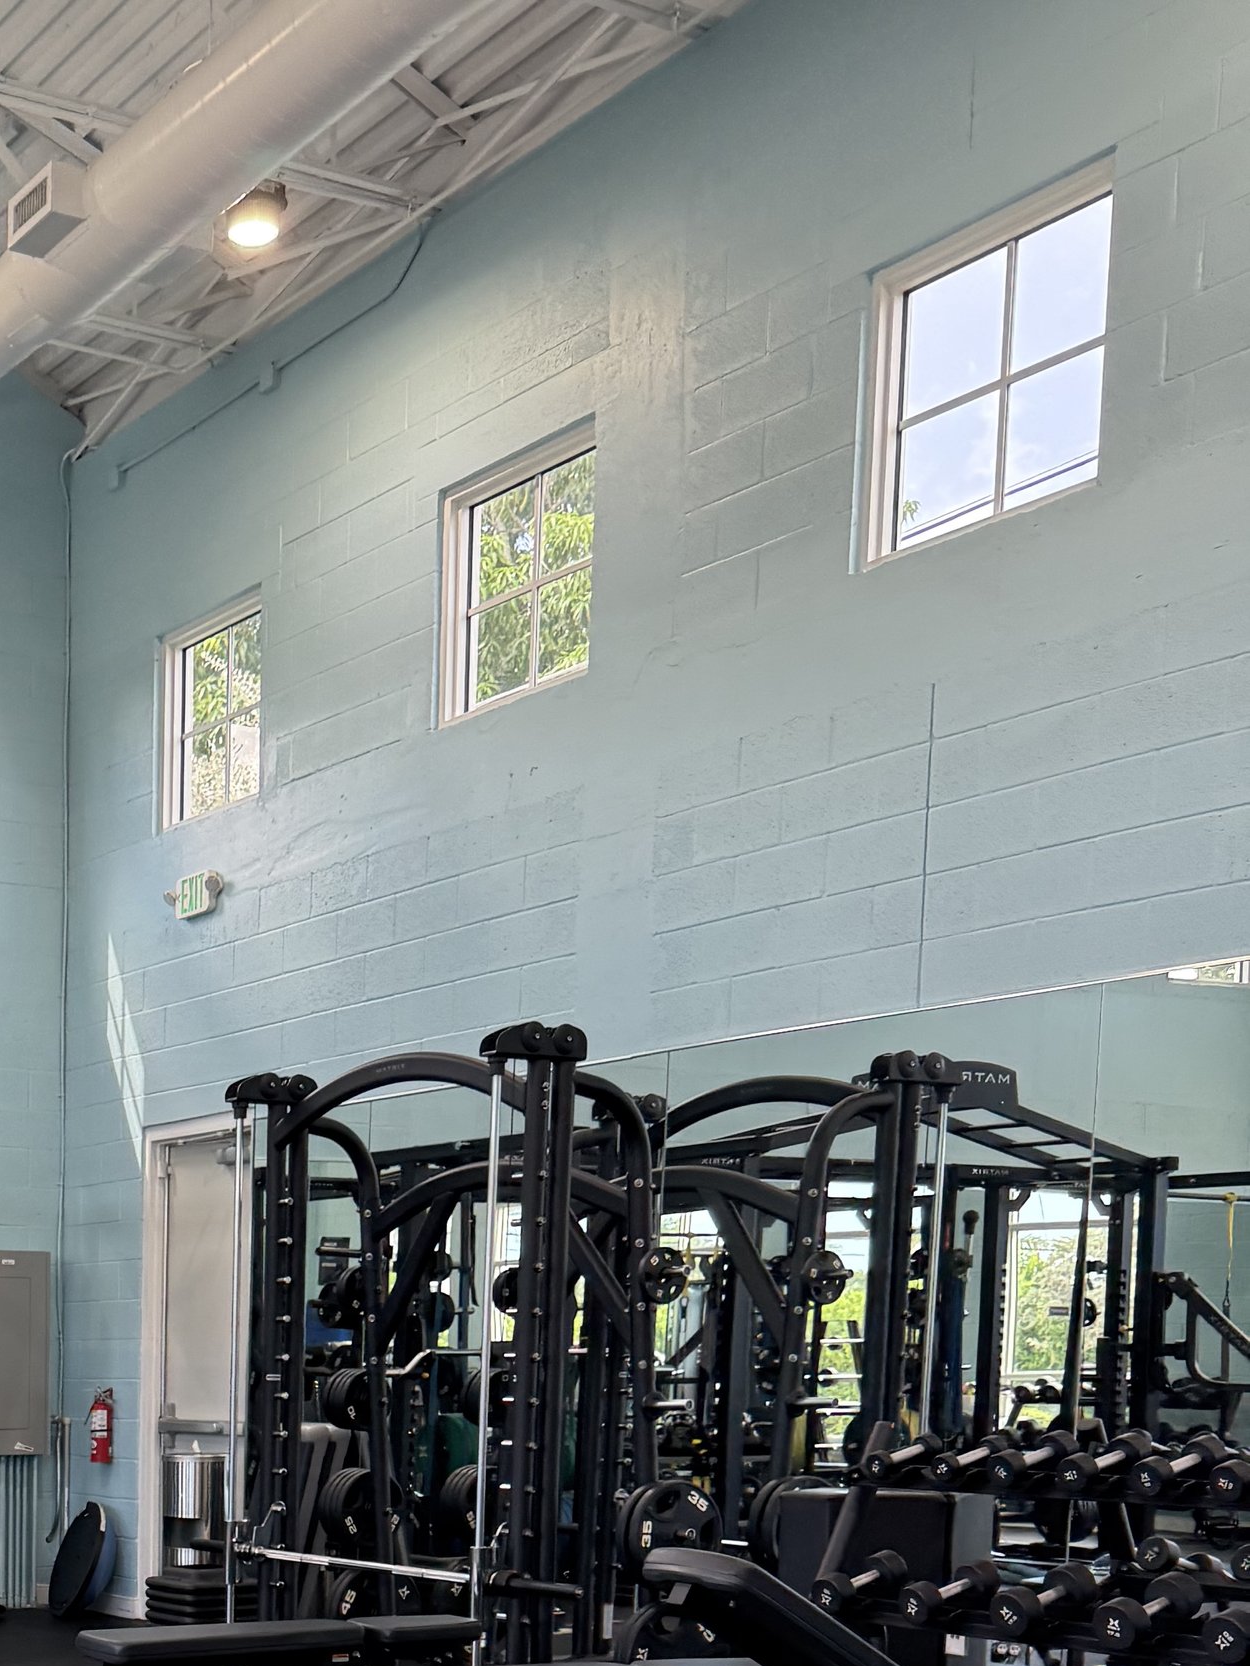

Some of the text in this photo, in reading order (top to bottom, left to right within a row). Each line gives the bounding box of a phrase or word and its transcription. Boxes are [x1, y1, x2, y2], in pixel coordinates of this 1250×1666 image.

[181, 872, 205, 915] EXIT
[687, 1490, 710, 1512] 35
[641, 1520, 653, 1548] 35
[341, 1589, 357, 1615] 45
